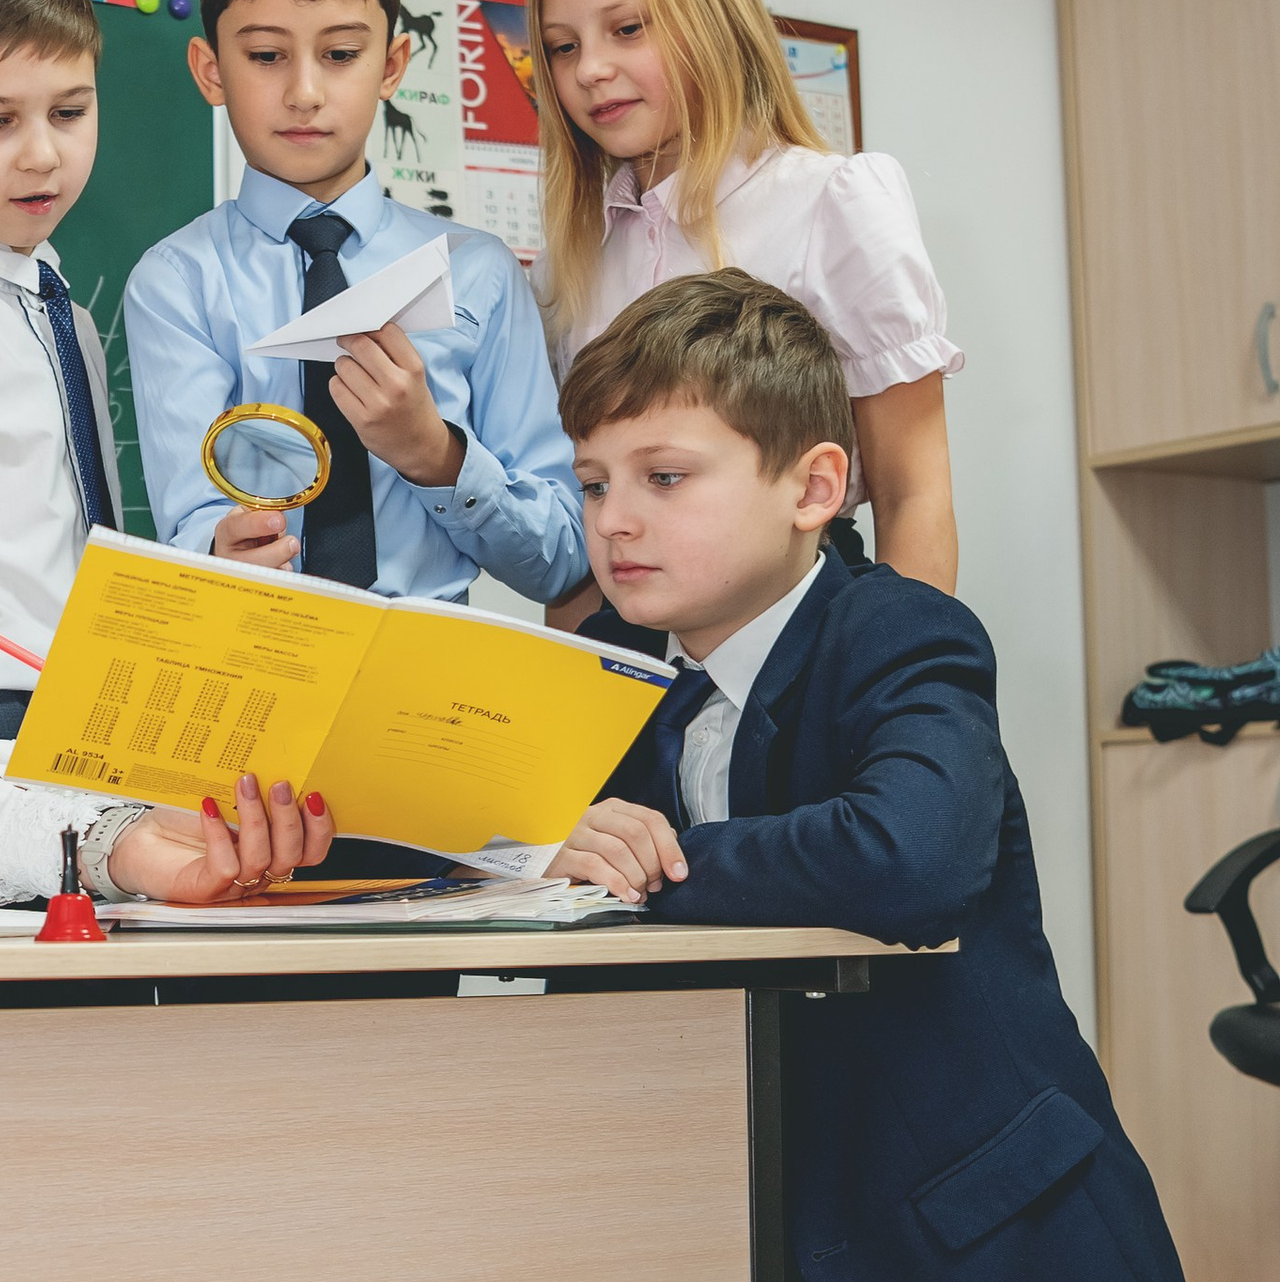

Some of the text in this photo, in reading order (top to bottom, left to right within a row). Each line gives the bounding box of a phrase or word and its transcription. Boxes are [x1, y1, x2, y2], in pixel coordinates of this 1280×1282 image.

[395, 88, 451, 106] ЖИРАФ
[391, 167, 436, 184] ЖУКИ
[486, 190, 494, 200] 3
[484, 204, 498, 215] 10
[506, 206, 518, 215] 11
[485, 219, 497, 229] 17
[178, 572, 294, 602] МЕТРИЧЕСКАЯ СИСТЕМА МЕР
[155, 656, 244, 680] ТАБЛИЦА УМНОЖЕНИЯ
[619, 666, 651, 680] Alingar
[450, 701, 512, 725] ТЕТРАДЬ
[66, 748, 104, 760] AL 9534
[478, 855, 526, 873] листов
[512, 852, 532, 864] 18
